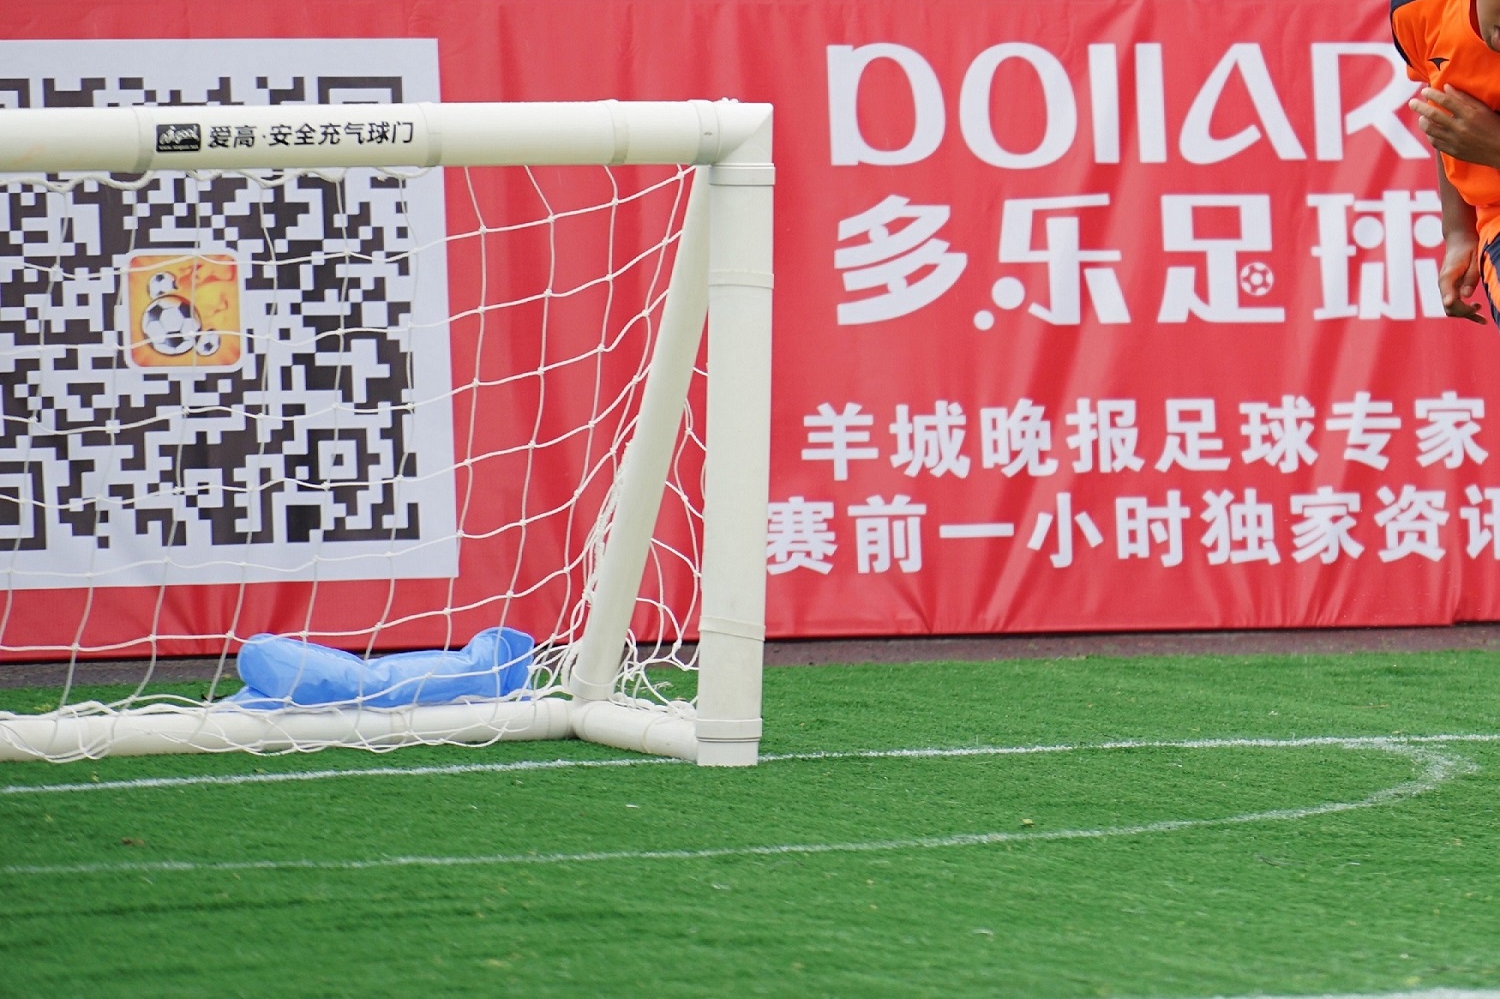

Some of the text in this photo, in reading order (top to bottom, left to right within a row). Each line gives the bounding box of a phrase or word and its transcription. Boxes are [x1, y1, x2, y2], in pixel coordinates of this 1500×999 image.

[834, 190, 1445, 331] 多乐足球
[801, 391, 1489, 482] 羊城晚报足球专家
